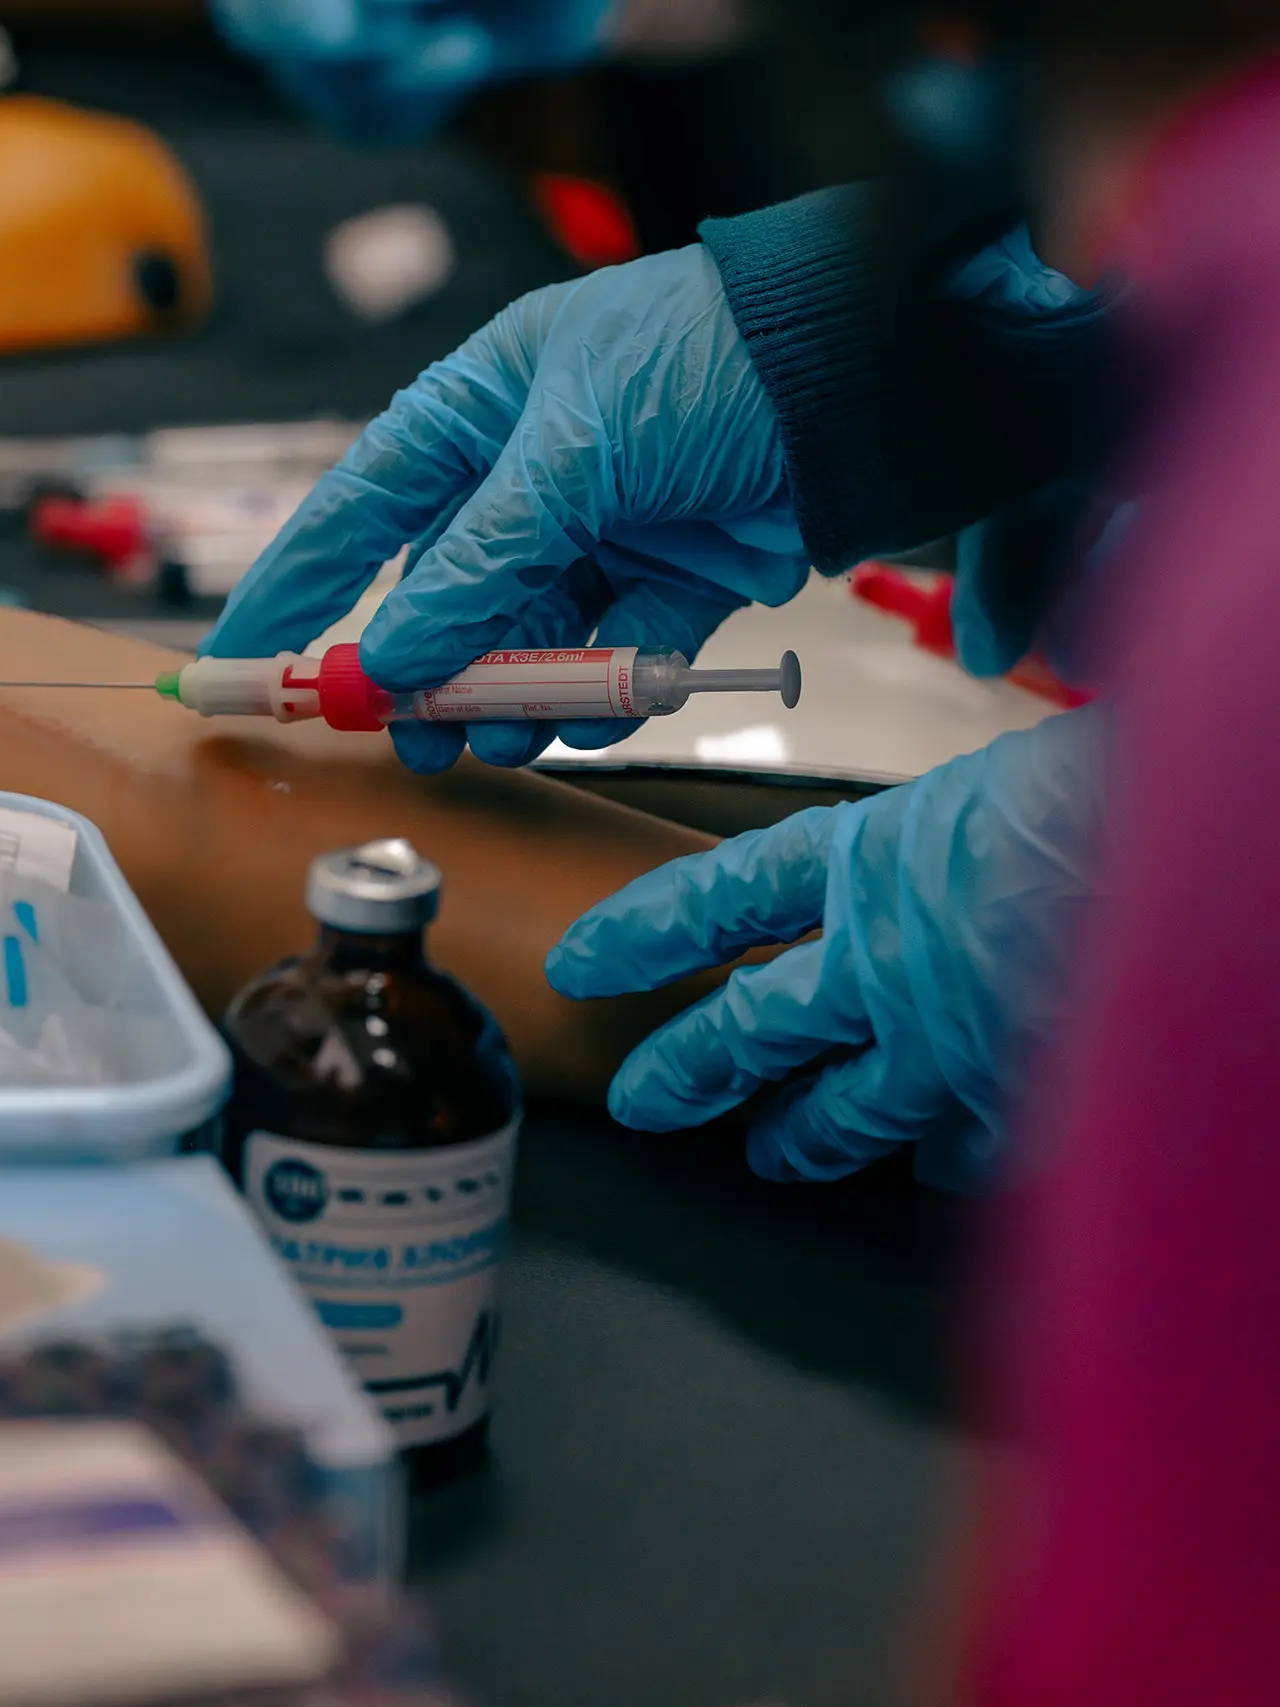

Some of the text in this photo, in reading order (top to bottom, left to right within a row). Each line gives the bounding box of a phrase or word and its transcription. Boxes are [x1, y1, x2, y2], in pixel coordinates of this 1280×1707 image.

[474, 652, 584, 663] DTA K3E/2.6ml
[451, 685, 474, 694] Name
